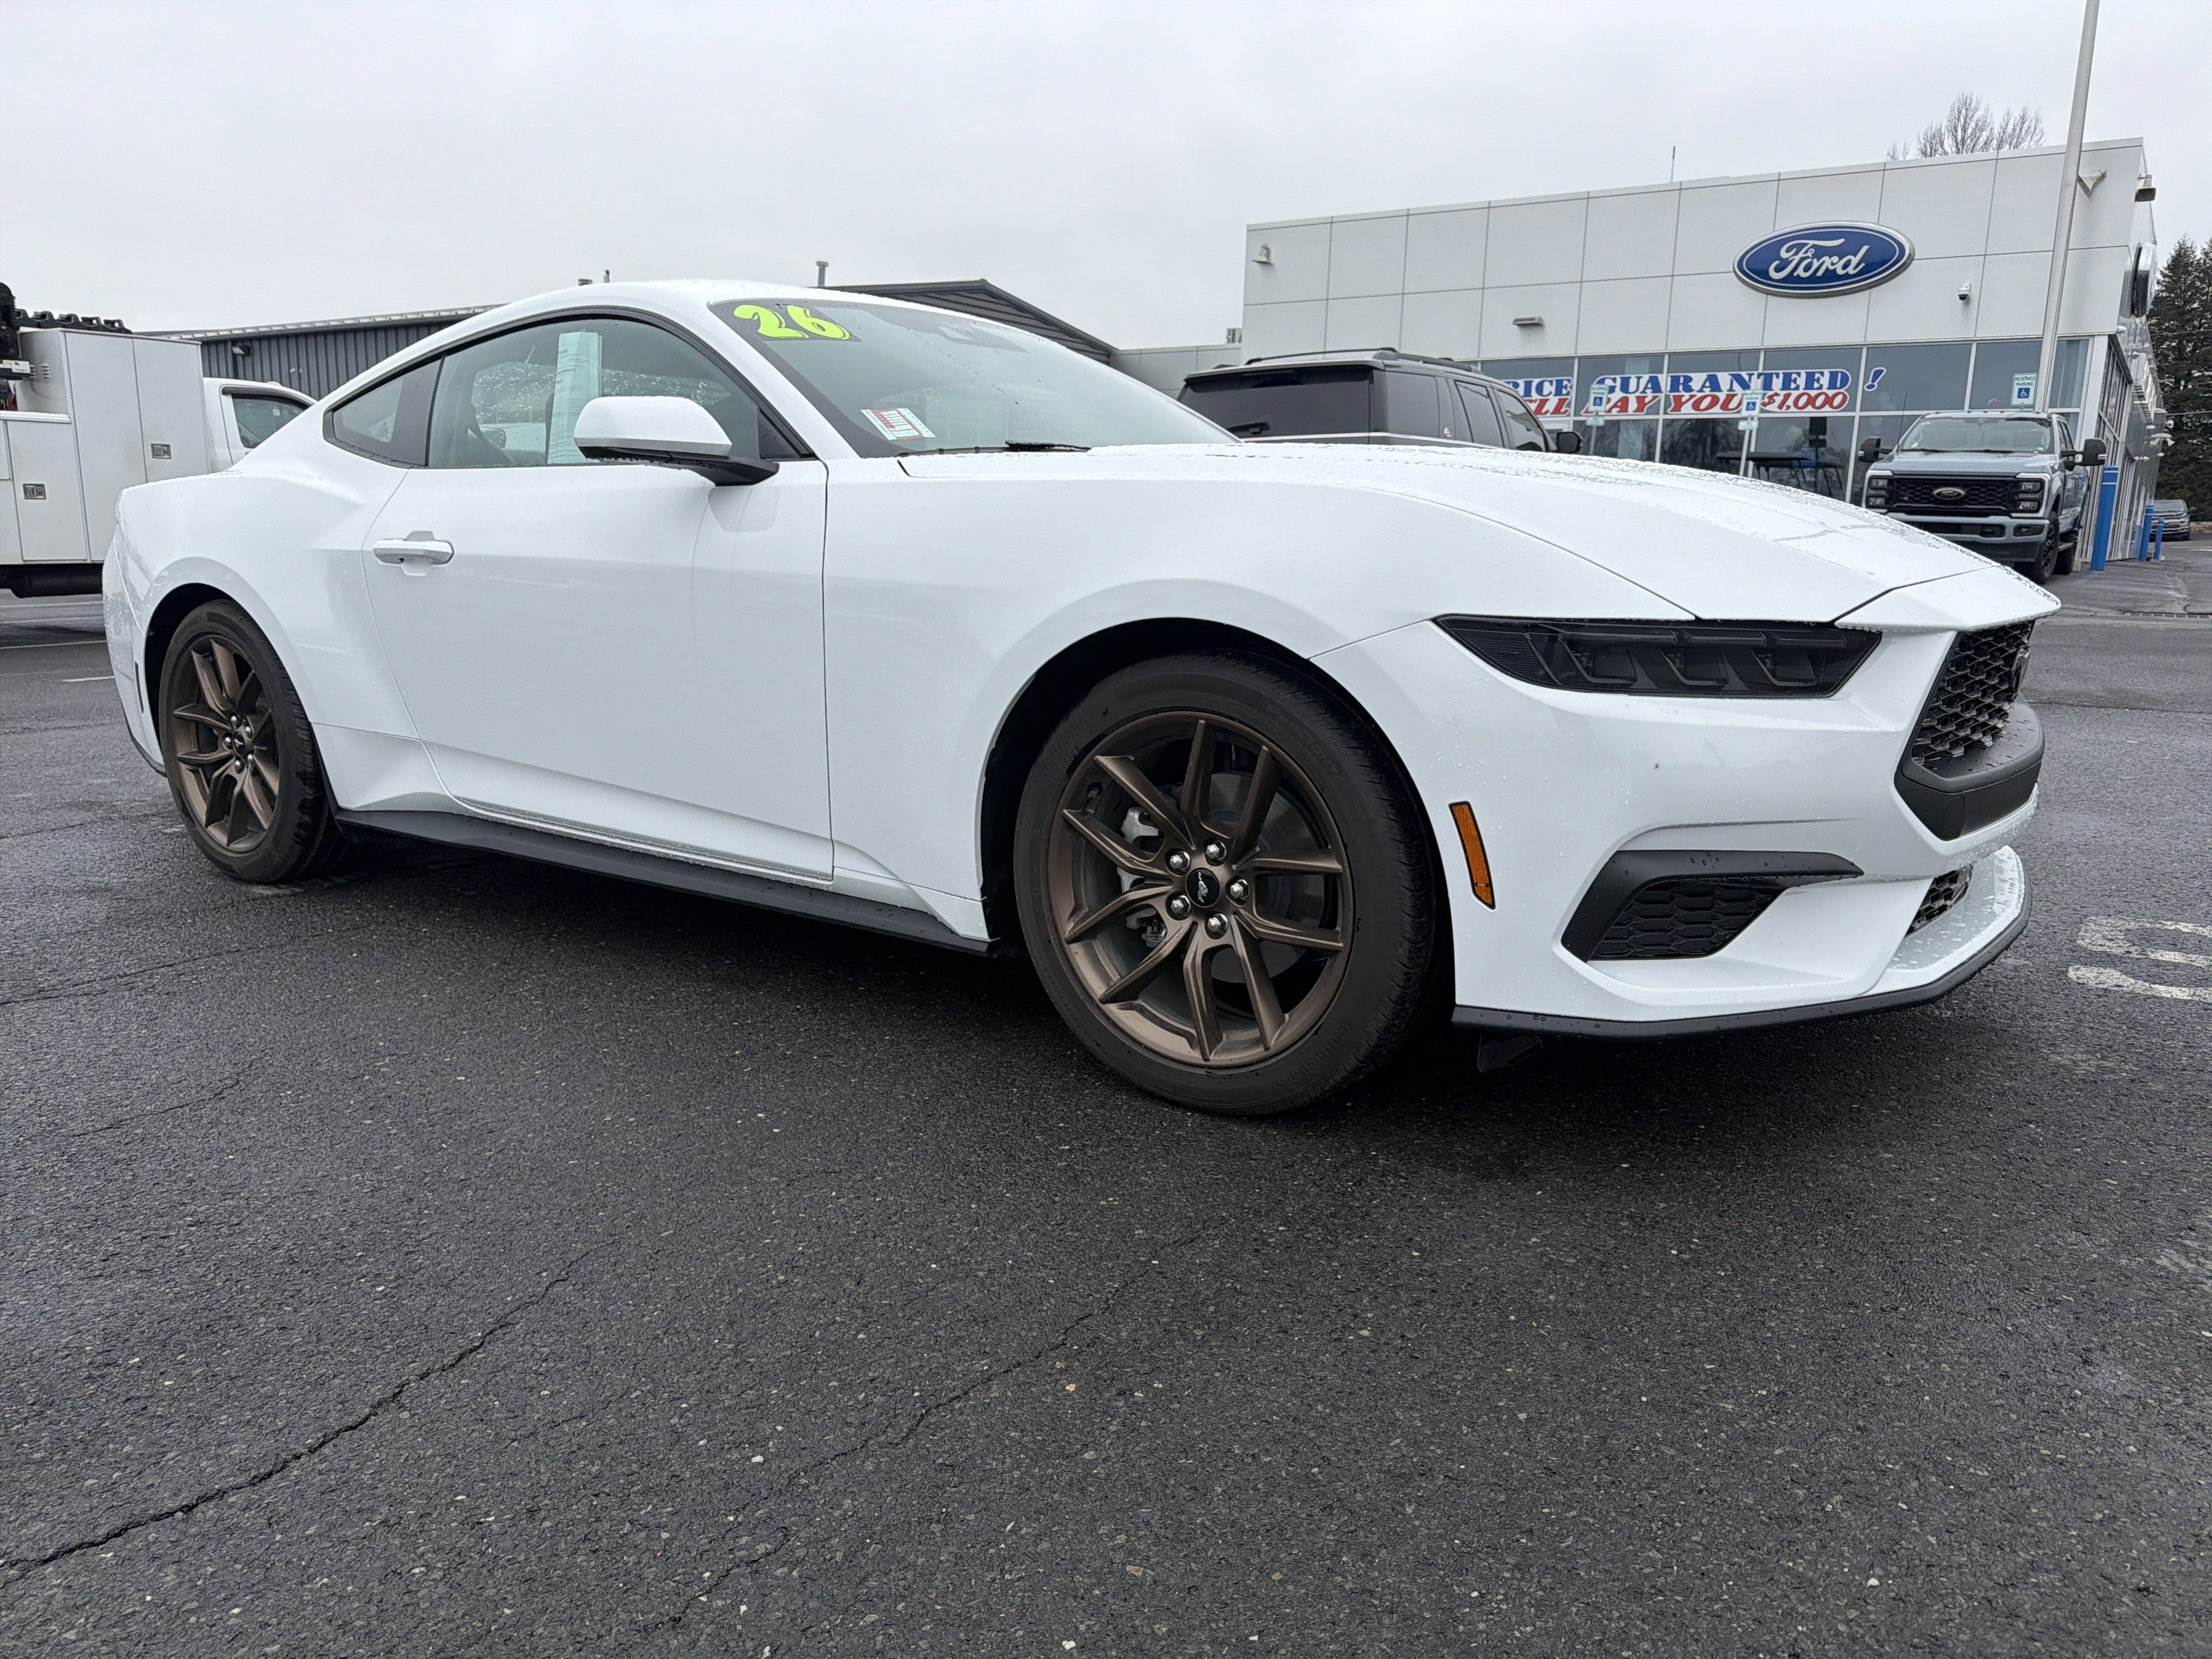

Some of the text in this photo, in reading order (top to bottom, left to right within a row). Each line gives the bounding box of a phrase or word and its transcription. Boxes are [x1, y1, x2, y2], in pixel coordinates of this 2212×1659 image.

[1768, 238, 1870, 280] Ford
[733, 304, 850, 340] 26
[1669, 393, 1744, 412] YOU
[1761, 392, 1848, 410] $1,000
